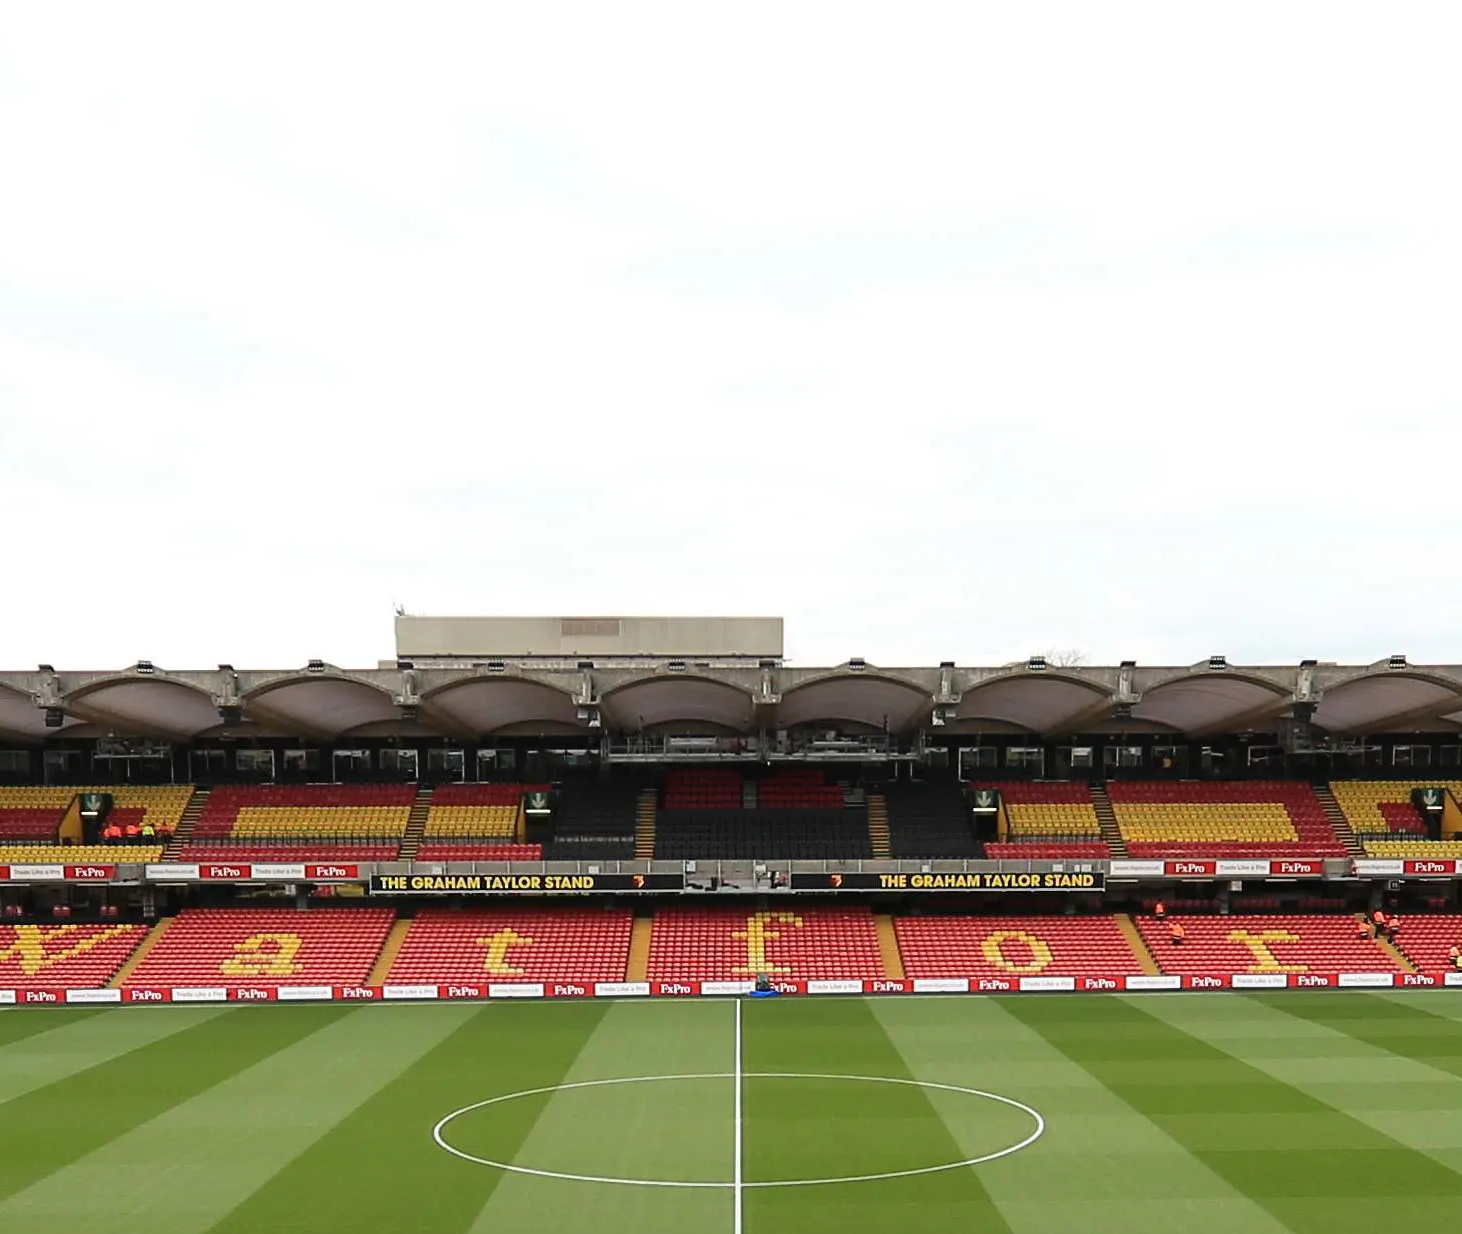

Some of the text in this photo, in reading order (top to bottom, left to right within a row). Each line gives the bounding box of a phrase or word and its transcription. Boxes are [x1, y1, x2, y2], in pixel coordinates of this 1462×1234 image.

[75, 867, 104, 877] FxPro
[211, 867, 240, 876] FxPro
[317, 867, 346, 876] FxPro
[1175, 864, 1205, 873] FxPro
[1281, 863, 1311, 872] FxPro
[1415, 862, 1444, 872] FxPro
[379, 876, 594, 889] THE GRAHAM TAYLOR STAND
[879, 875, 1094, 888] THE GRAHAM TAYLOR STAND
[980, 980, 1010, 990] FxPro
[1086, 978, 1115, 989] FxPro
[1192, 977, 1221, 987] FxPro
[1298, 975, 1328, 986] FxPro
[1404, 974, 1434, 985] FxPro
[449, 986, 478, 997] FxPro
[555, 985, 584, 996] FxPro
[661, 984, 690, 994] FxPro
[874, 981, 903, 992] FxPro
[26, 991, 56, 1002] FxPro
[132, 990, 161, 1001] FxPro
[238, 989, 267, 1000] FxPro
[343, 988, 373, 998] FxPro
